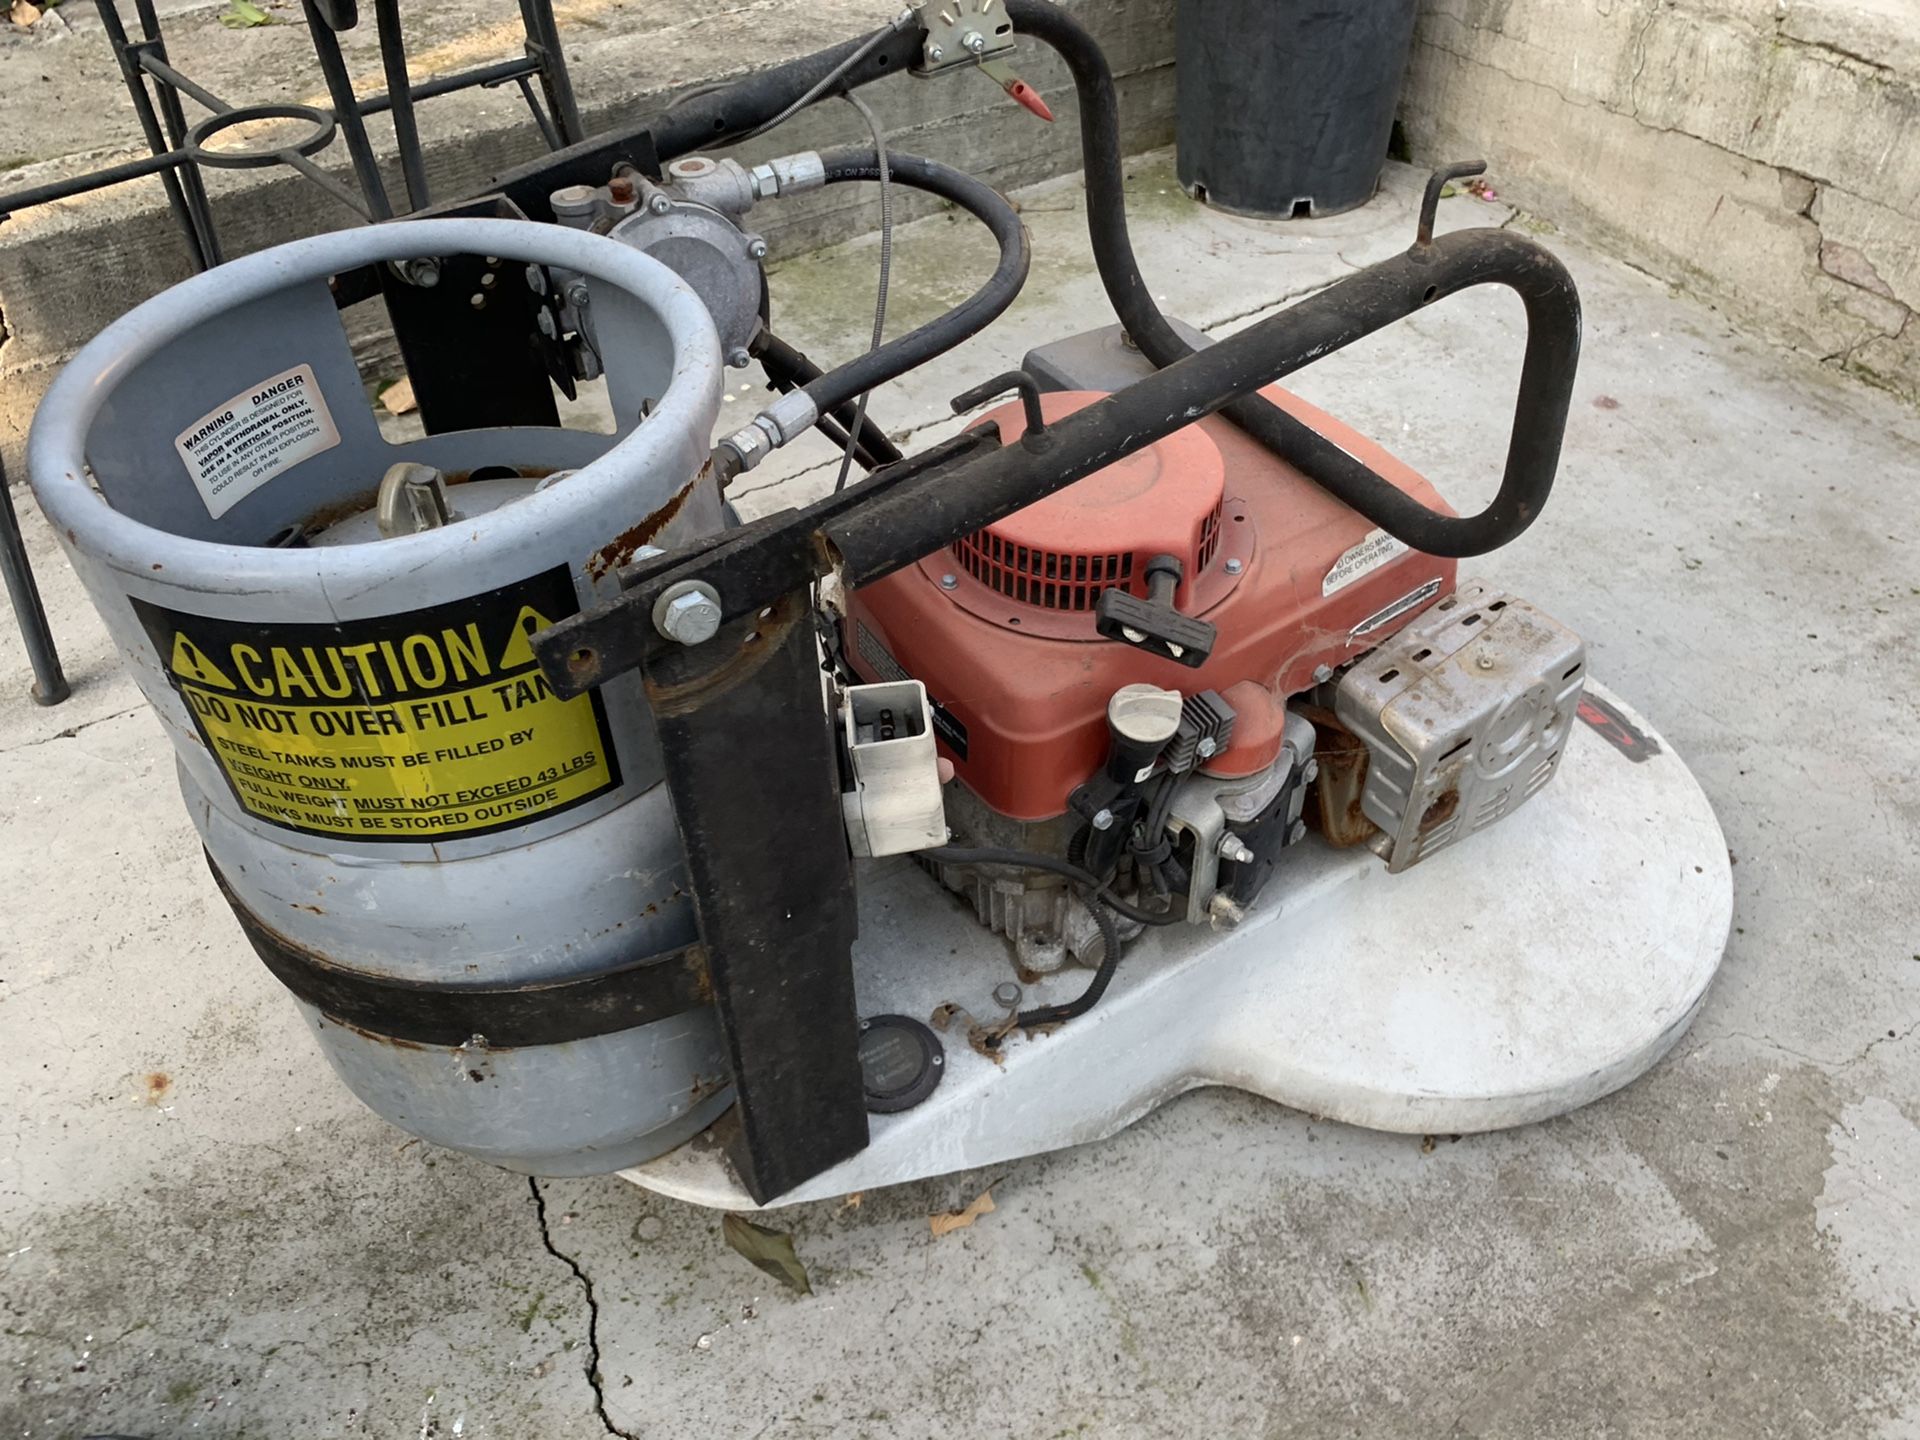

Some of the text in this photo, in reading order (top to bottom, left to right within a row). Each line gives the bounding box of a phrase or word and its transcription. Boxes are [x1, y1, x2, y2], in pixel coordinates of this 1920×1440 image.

[183, 375, 305, 450] WARNING DANGER
[194, 390, 303, 457] THIS CYLINDER IS DESIGNED FOR
[198, 399, 308, 467] VAPOR WITHDRAWAL ONLY.
[201, 408, 315, 479] USE IN A VERTICAL POSITION.
[208, 418, 314, 484] TO USE IN ANY OTHER POSITION
[212, 427, 320, 495] COULD RESULT IN AN EXPLOSION
[252, 467, 264, 478] OR
[1325, 542, 1394, 586] BEFORE OPERATING
[1344, 544, 1375, 566] OWNERS
[230, 622, 491, 699] CAUTION
[187, 673, 556, 737] DO NOT OVER FILL TAN
[216, 728, 534, 769] STEEL TANKS MUST BE FILLED BY
[227, 757, 351, 791] WEIGHT ONLY.
[238, 750, 597, 811] FULL WEIGHT MUST NOT EXCEED 43 LBS
[247, 787, 559, 829] TANKS MUST BE STORED OUTSIDE
